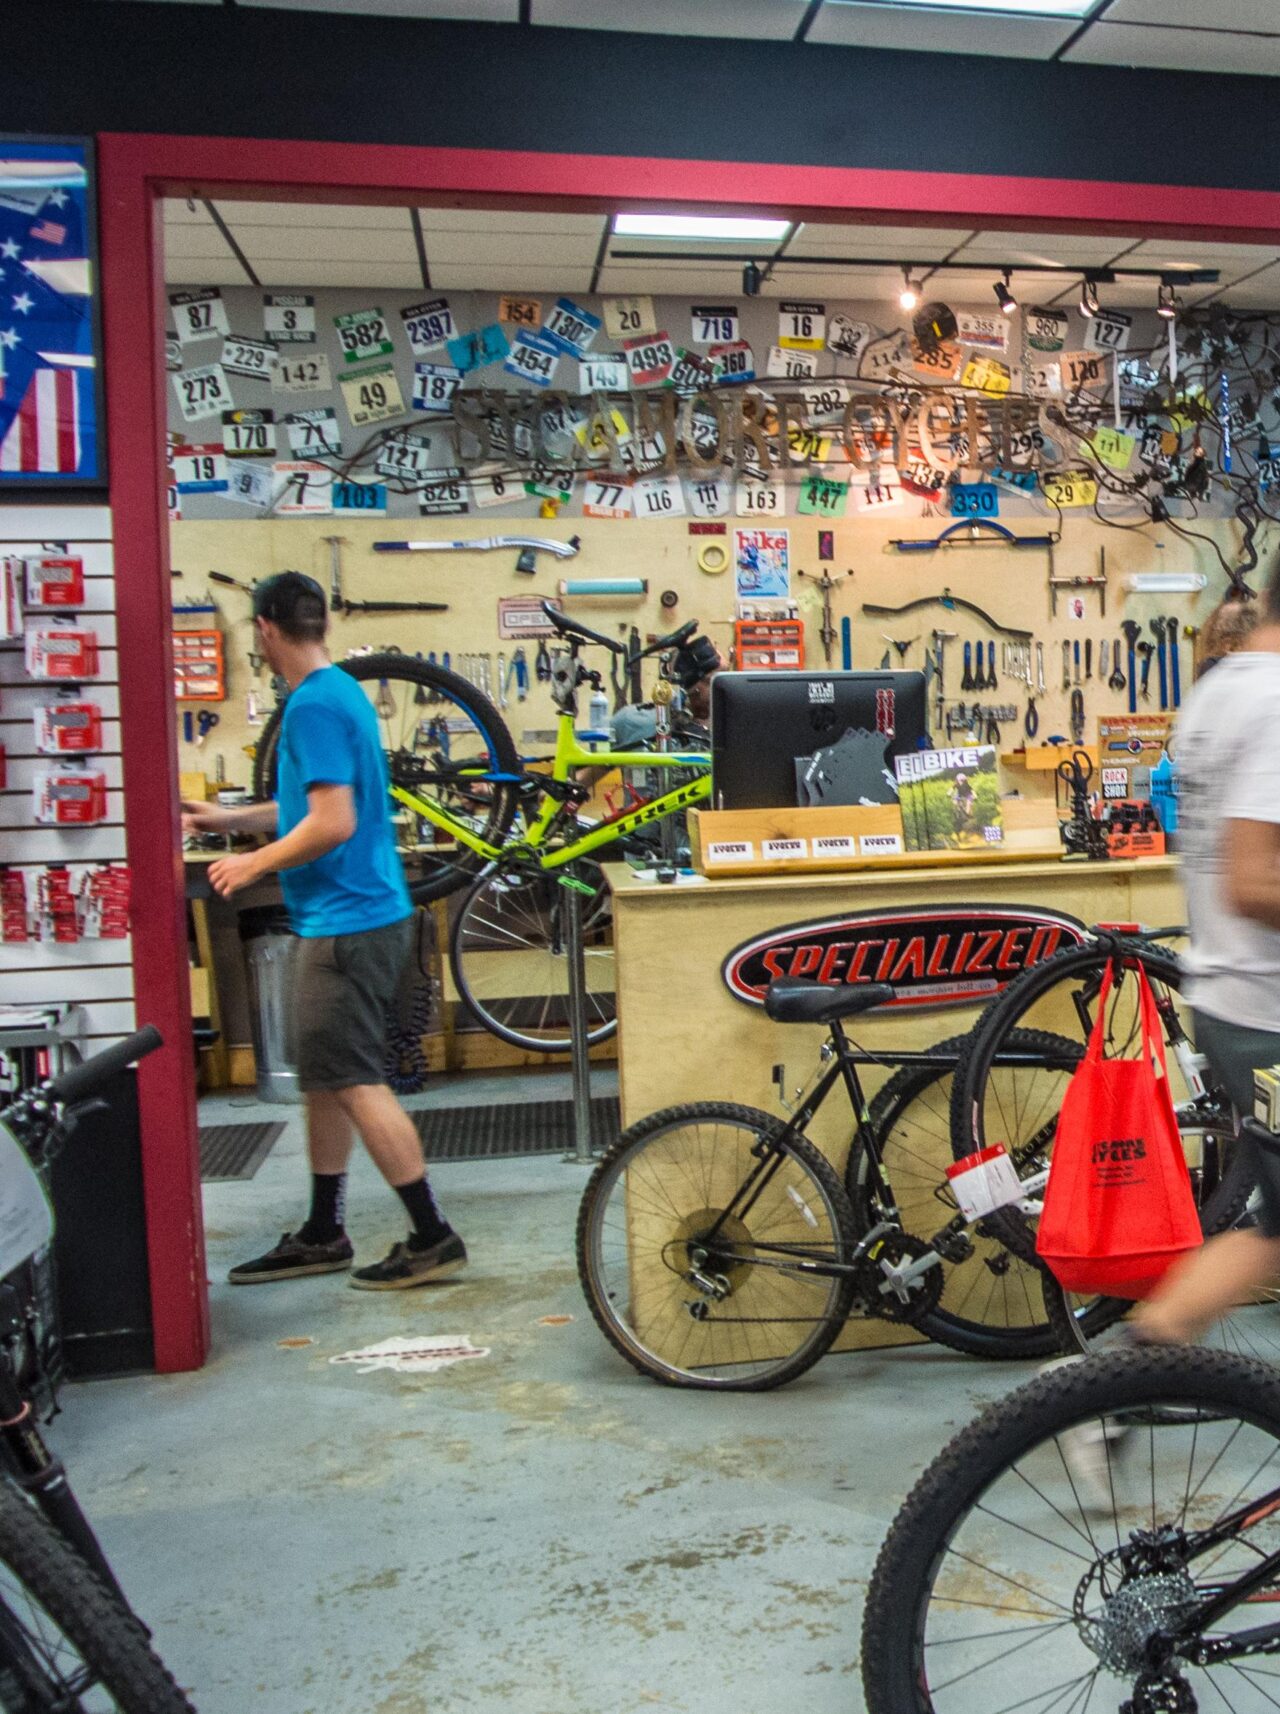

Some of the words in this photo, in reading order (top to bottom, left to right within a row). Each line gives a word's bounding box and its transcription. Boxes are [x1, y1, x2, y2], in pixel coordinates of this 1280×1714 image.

[188, 304, 211, 328] 87
[284, 310, 296, 329] 3
[506, 303, 534, 322] 154
[619, 311, 641, 330] 20
[341, 320, 388, 350] 582
[407, 312, 452, 344] 2397
[700, 318, 733, 340] 719
[793, 316, 812, 337] 16
[974, 320, 993, 331] 355
[1095, 321, 1124, 346] 127
[234, 346, 265, 367] 229
[513, 346, 553, 376] 454
[632, 344, 672, 374] 493
[722, 351, 746, 374] 360
[281, 362, 320, 383] 142
[183, 375, 222, 402] 273
[361, 382, 388, 410] 49
[419, 375, 461, 401] 187
[233, 425, 267, 448] 170
[192, 457, 215, 480] 19
[385, 445, 419, 469] 121
[293, 473, 309, 504] 7
[340, 485, 377, 510] 103
[595, 484, 624, 506] 77
[746, 491, 777, 509] 163
[808, 486, 841, 510] 447
[1055, 485, 1074, 503] 29
[646, 490, 672, 512] 116
[954, 492, 994, 513] 330
[736, 531, 788, 550] bike
[923, 750, 979, 770] BIKE
[1104, 770, 1126, 782] ROCK
[609, 786, 701, 833] TREK
[762, 925, 1062, 986] SPECIALIZED
